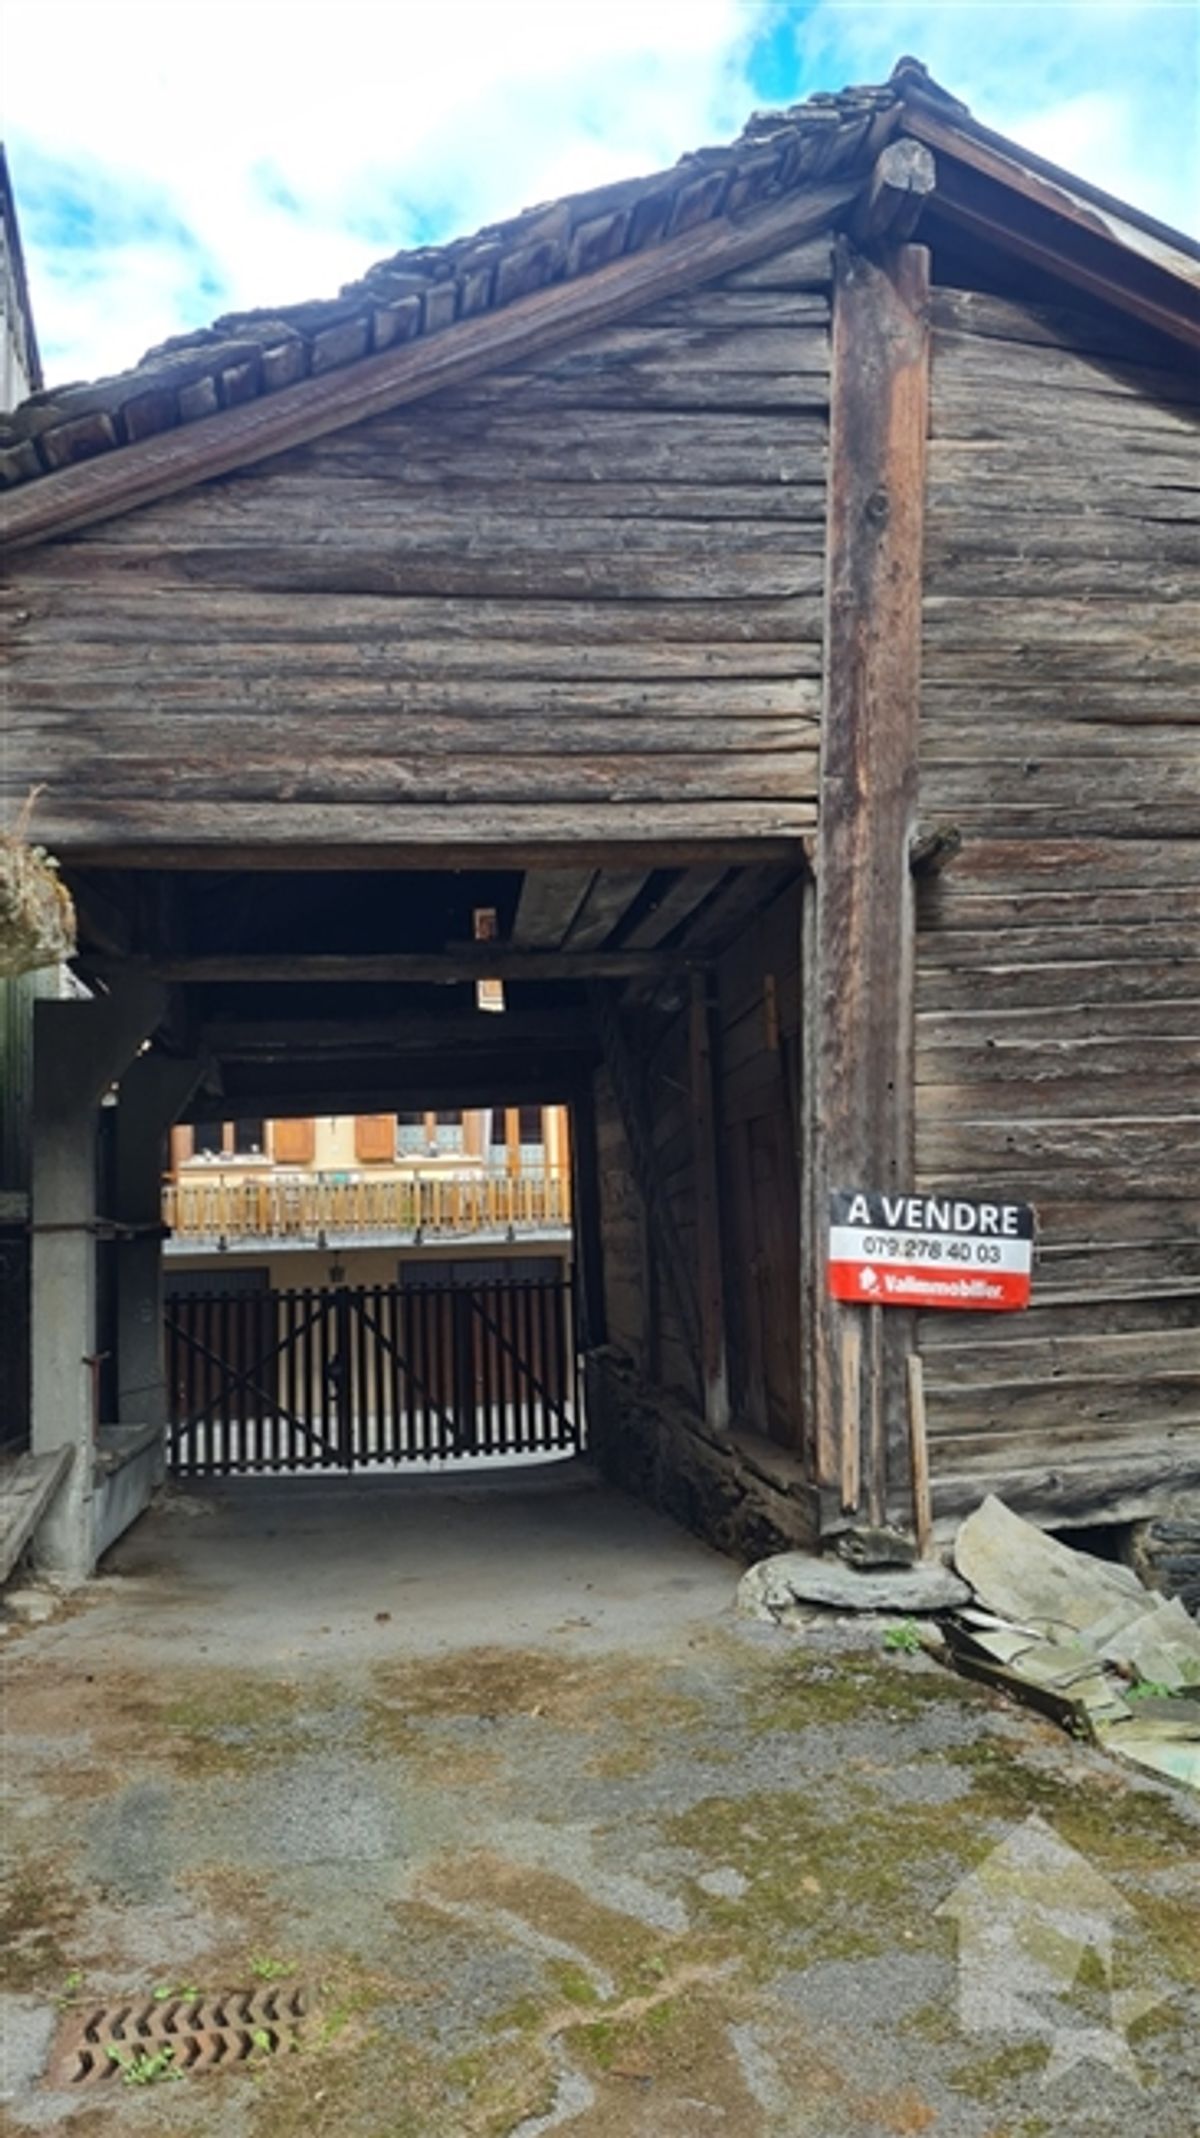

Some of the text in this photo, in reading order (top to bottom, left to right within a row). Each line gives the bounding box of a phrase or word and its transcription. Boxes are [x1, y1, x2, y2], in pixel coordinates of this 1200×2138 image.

[849, 1194, 1018, 1235] A VENDRE
[946, 1243, 972, 1262] 40
[977, 1245, 1001, 1264] 03
